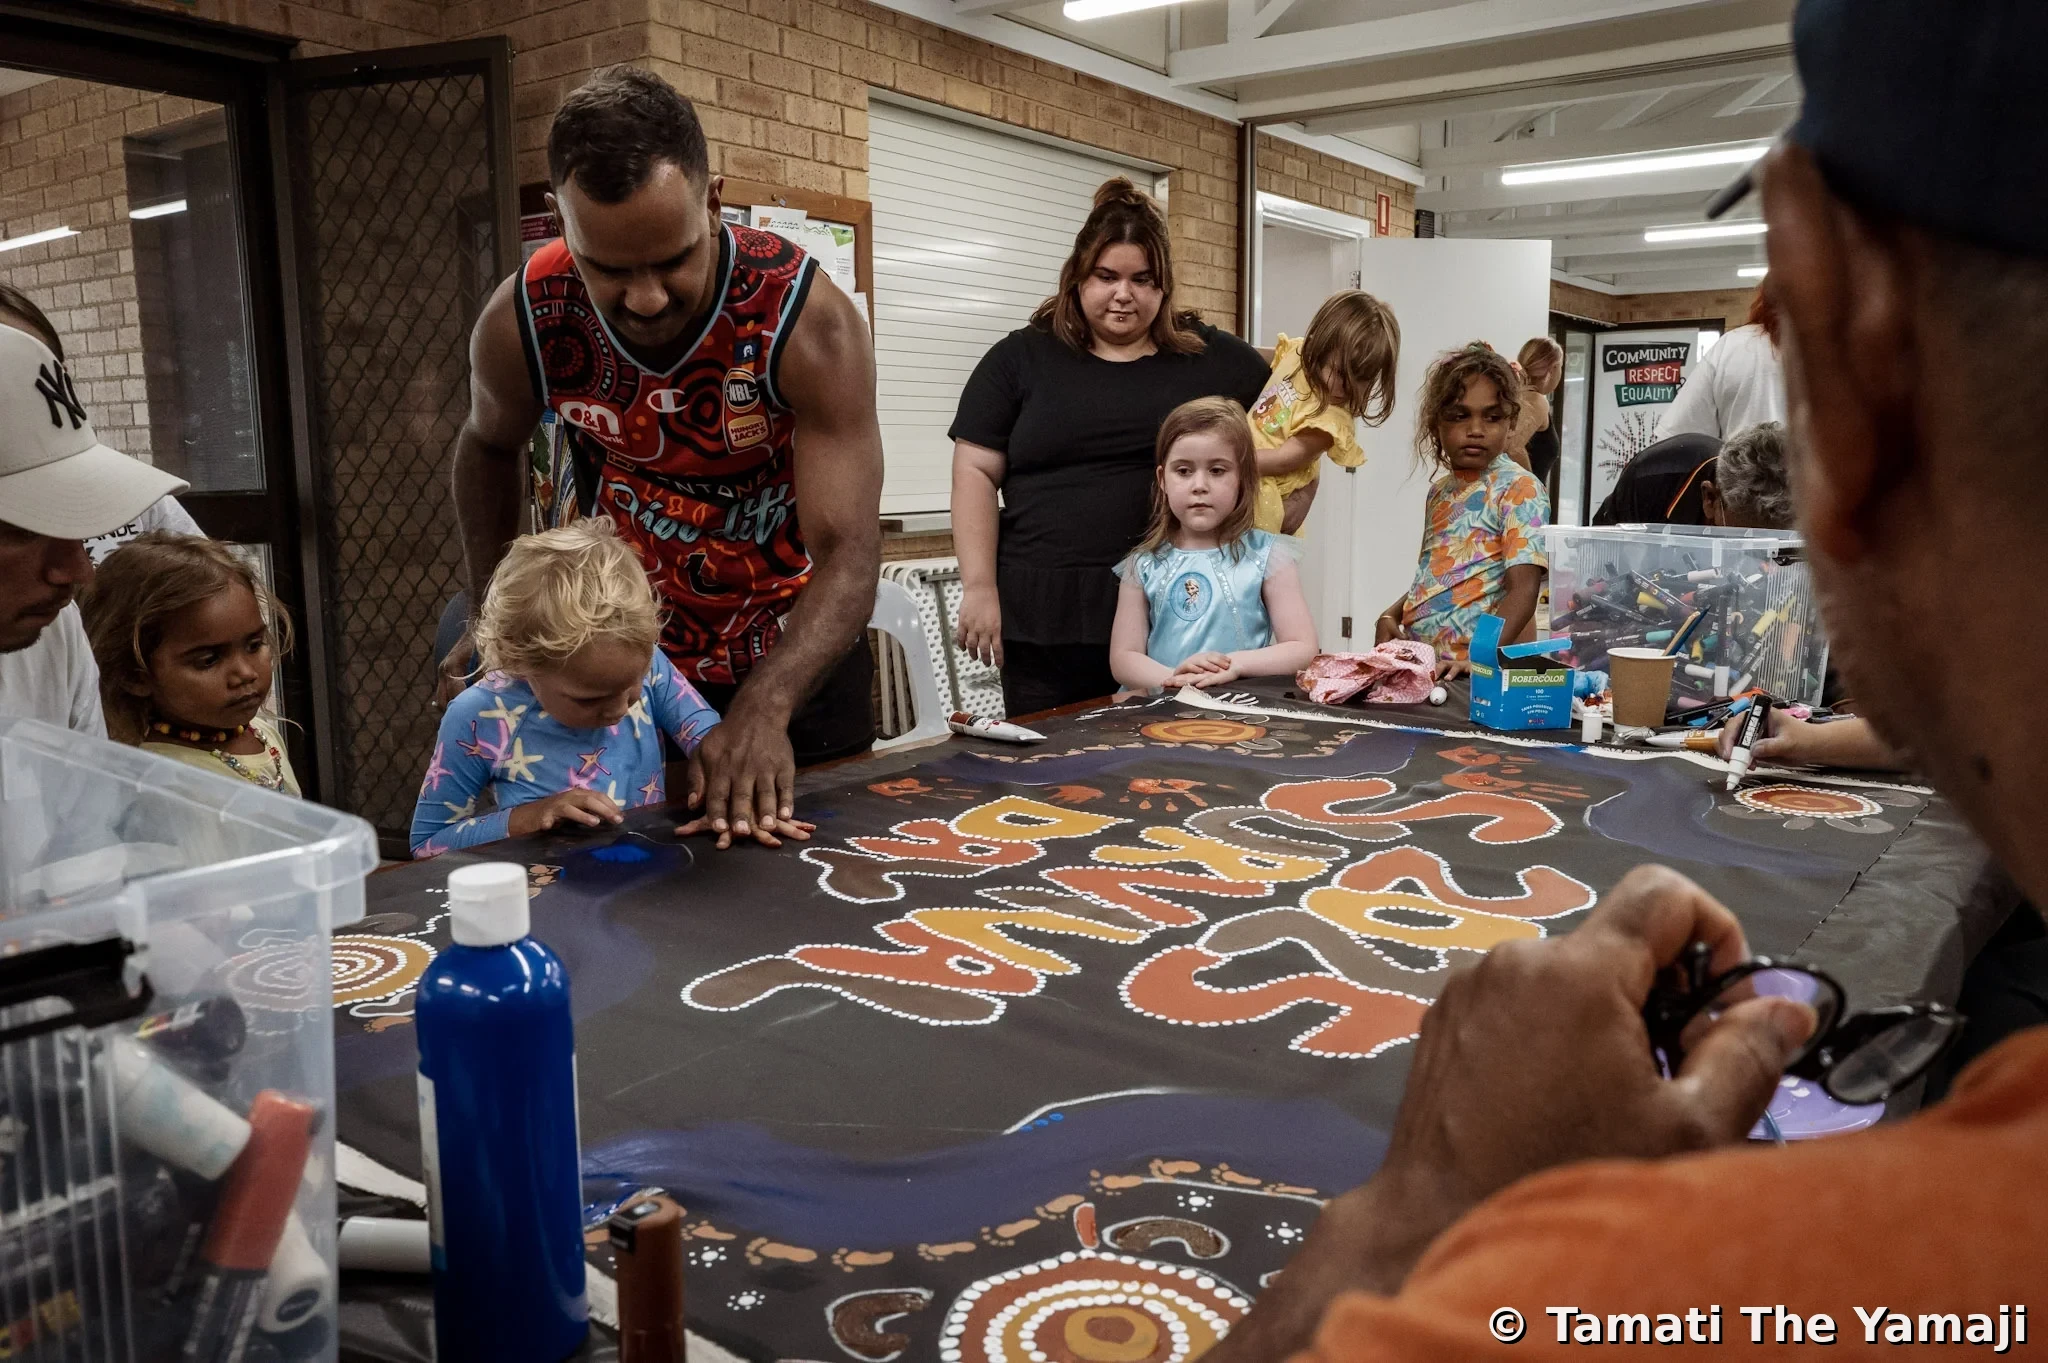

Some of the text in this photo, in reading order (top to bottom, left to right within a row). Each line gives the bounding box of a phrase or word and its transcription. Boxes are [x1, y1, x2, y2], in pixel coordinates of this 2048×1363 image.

[1606, 346, 1687, 366] COMMUNITY
[1629, 366, 1679, 382] RESPECT
[728, 383, 753, 402] NBL
[1621, 386, 1674, 403] EQUALITY
[730, 421, 765, 433] HUNGRY
[733, 428, 767, 442] JACK'S
[1511, 674, 1565, 684] ROBERCOLOR
